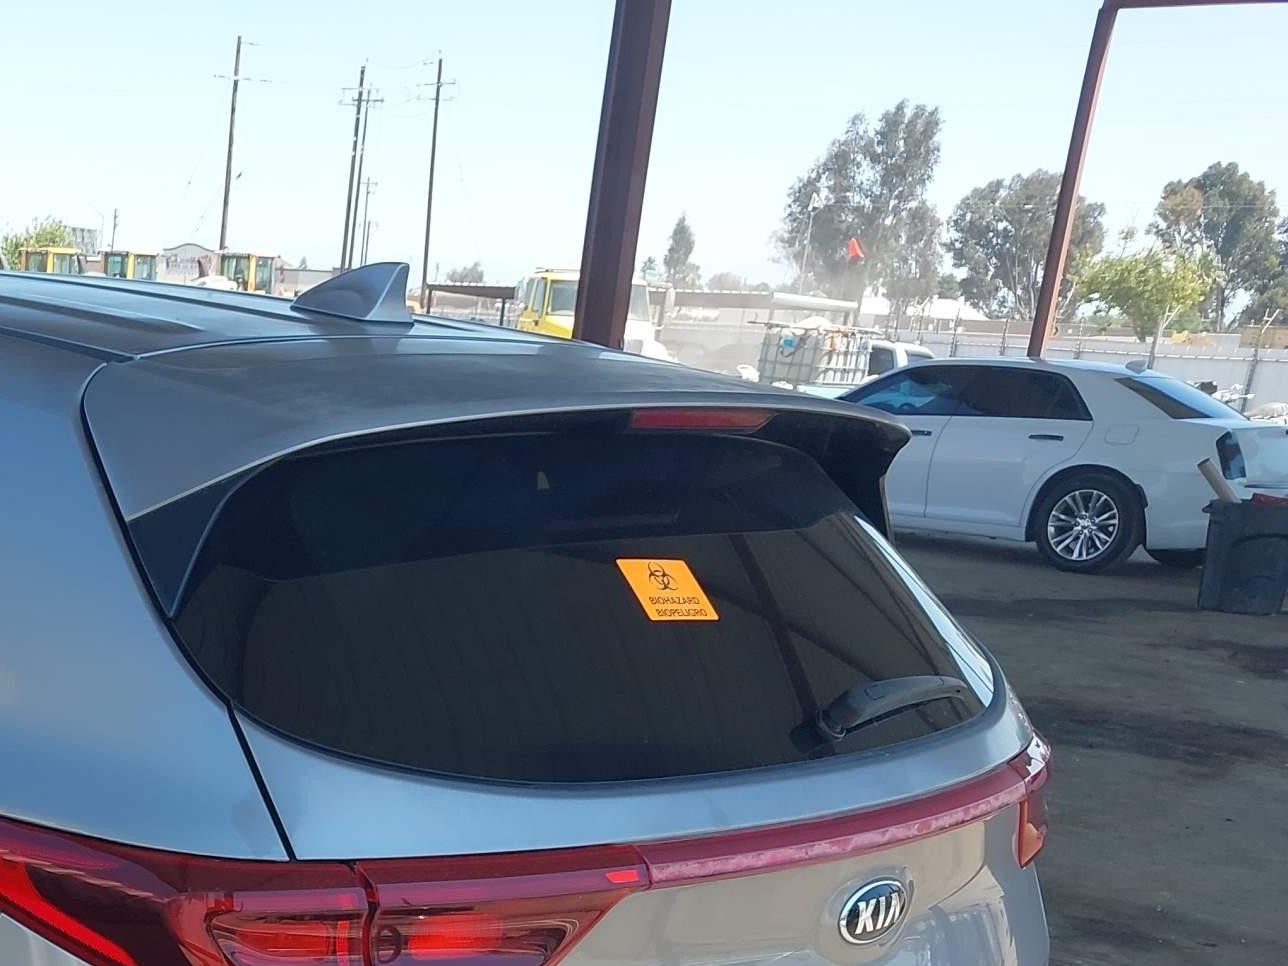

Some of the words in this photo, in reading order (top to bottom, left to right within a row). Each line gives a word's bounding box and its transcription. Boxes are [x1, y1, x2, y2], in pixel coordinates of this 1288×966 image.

[648, 596, 701, 605] BIOHAZARD
[655, 608, 708, 617] BIOPELIGRO
[854, 891, 901, 935] KIA
